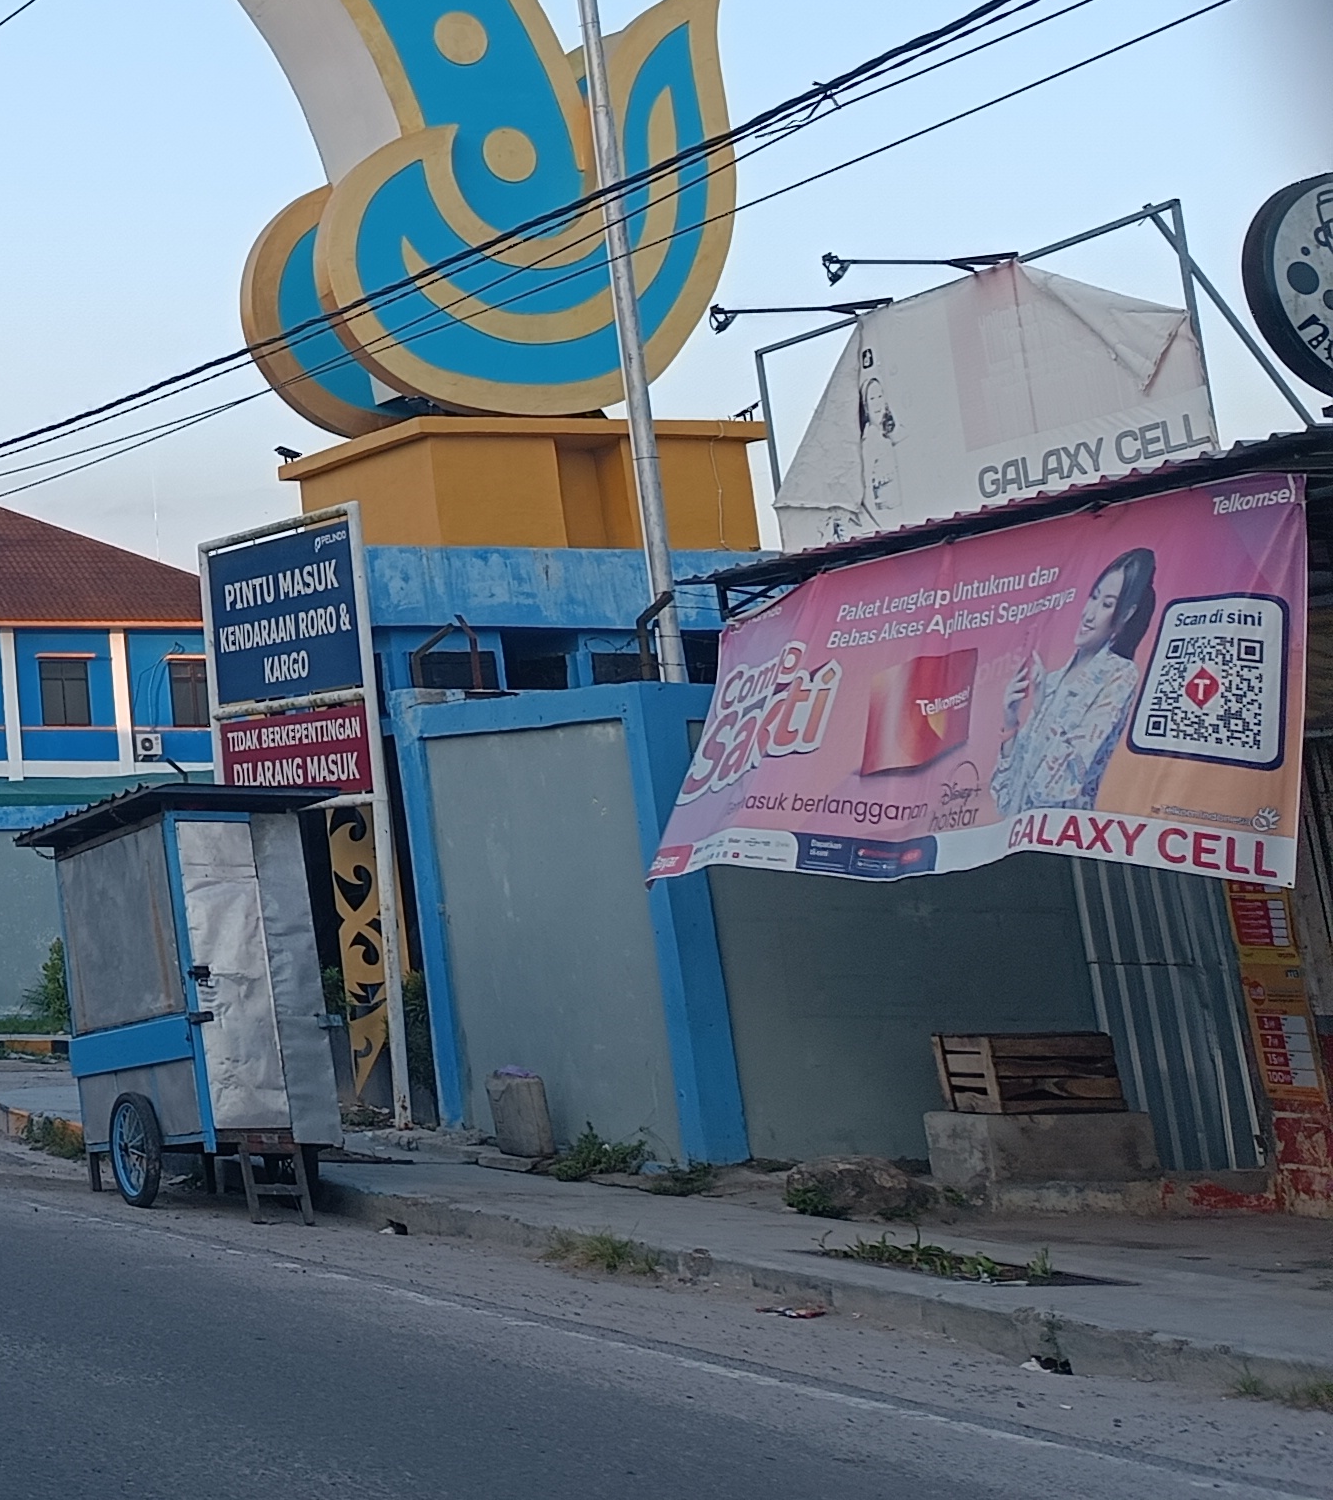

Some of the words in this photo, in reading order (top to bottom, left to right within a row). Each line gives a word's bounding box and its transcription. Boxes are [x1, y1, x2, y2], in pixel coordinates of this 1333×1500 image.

[977, 437, 1104, 499] GALAXY
[1114, 414, 1211, 465] CELL
[1212, 474, 1296, 516] Telkomsel
[320, 530, 347, 546] PELINDO
[224, 574, 275, 612] PINTU
[279, 559, 339, 601] MASUK
[836, 602, 881, 623] Paket
[882, 588, 951, 614] Lengkap
[951, 573, 1026, 603] Untukmu
[1027, 565, 1060, 587] dan
[218, 612, 296, 654] KENDARAAN
[298, 604, 335, 639] RORO
[338, 602, 352, 633] &
[826, 628, 877, 649] Bebas
[878, 617, 925, 643] Akses
[925, 604, 996, 639] Aplikasi
[1174, 612, 1207, 628] Scan
[1209, 608, 1225, 624] di
[1226, 609, 1263, 627] sini
[263, 649, 310, 685] KARGO
[226, 730, 260, 753] TIDAK
[260, 715, 362, 749] BERKEPENTINGAN
[676, 659, 843, 805] Sakti
[233, 755, 304, 787] DILARANG
[306, 750, 361, 784] MASUK
[791, 793, 929, 825] berlangganan
[927, 804, 980, 833] hotstar
[1008, 813, 1148, 857] GALAXY
[1156, 827, 1279, 879] CELL
